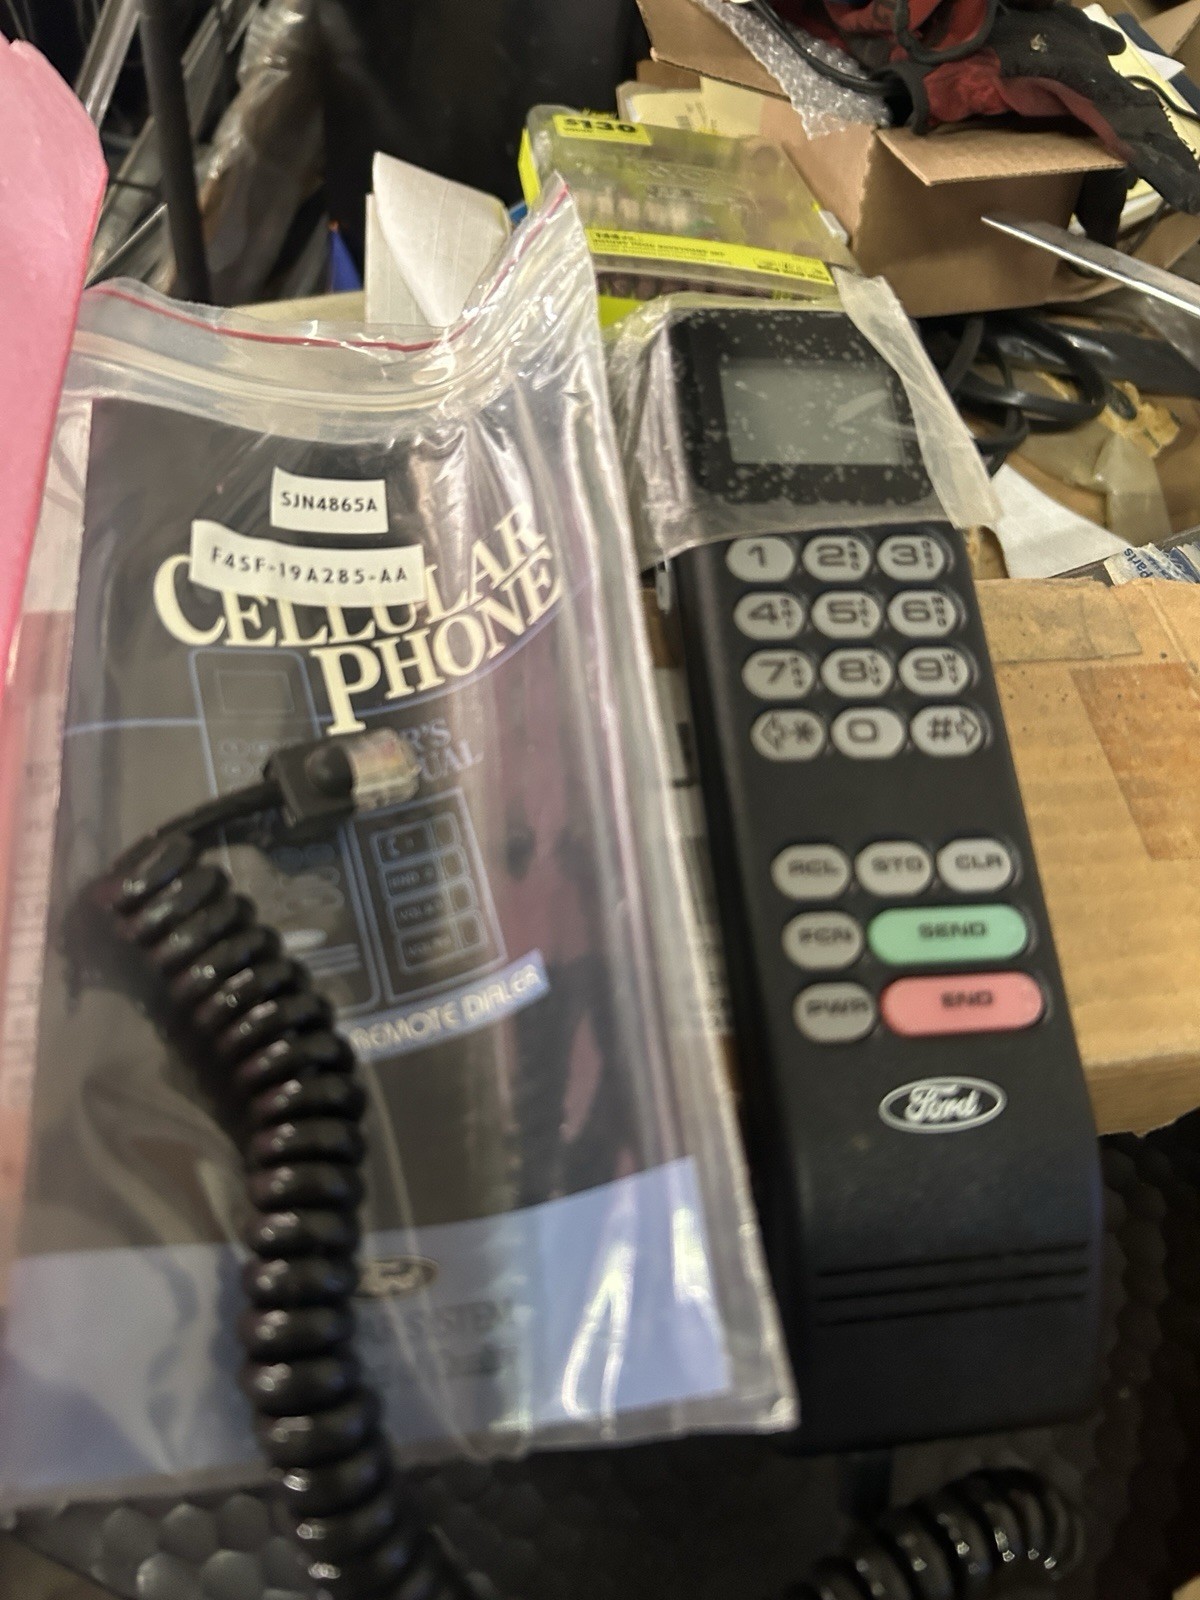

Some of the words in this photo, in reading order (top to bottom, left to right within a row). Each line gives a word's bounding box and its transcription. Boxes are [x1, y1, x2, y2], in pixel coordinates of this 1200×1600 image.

[281, 491, 378, 512] SJN4865A
[749, 544, 767, 567] 1
[816, 543, 847, 566] 2
[890, 543, 919, 566] 3
[748, 601, 779, 625] 4
[826, 600, 857, 624] 5
[901, 599, 931, 622] 6
[310, 546, 562, 736] PHONE
[757, 659, 786, 685] 7
[836, 658, 868, 683] 8
[912, 656, 944, 681] 9
[954, 853, 1002, 870] CLR
[918, 920, 988, 939] SEND
[941, 990, 994, 1009] END
[904, 1083, 984, 1124] Ford
